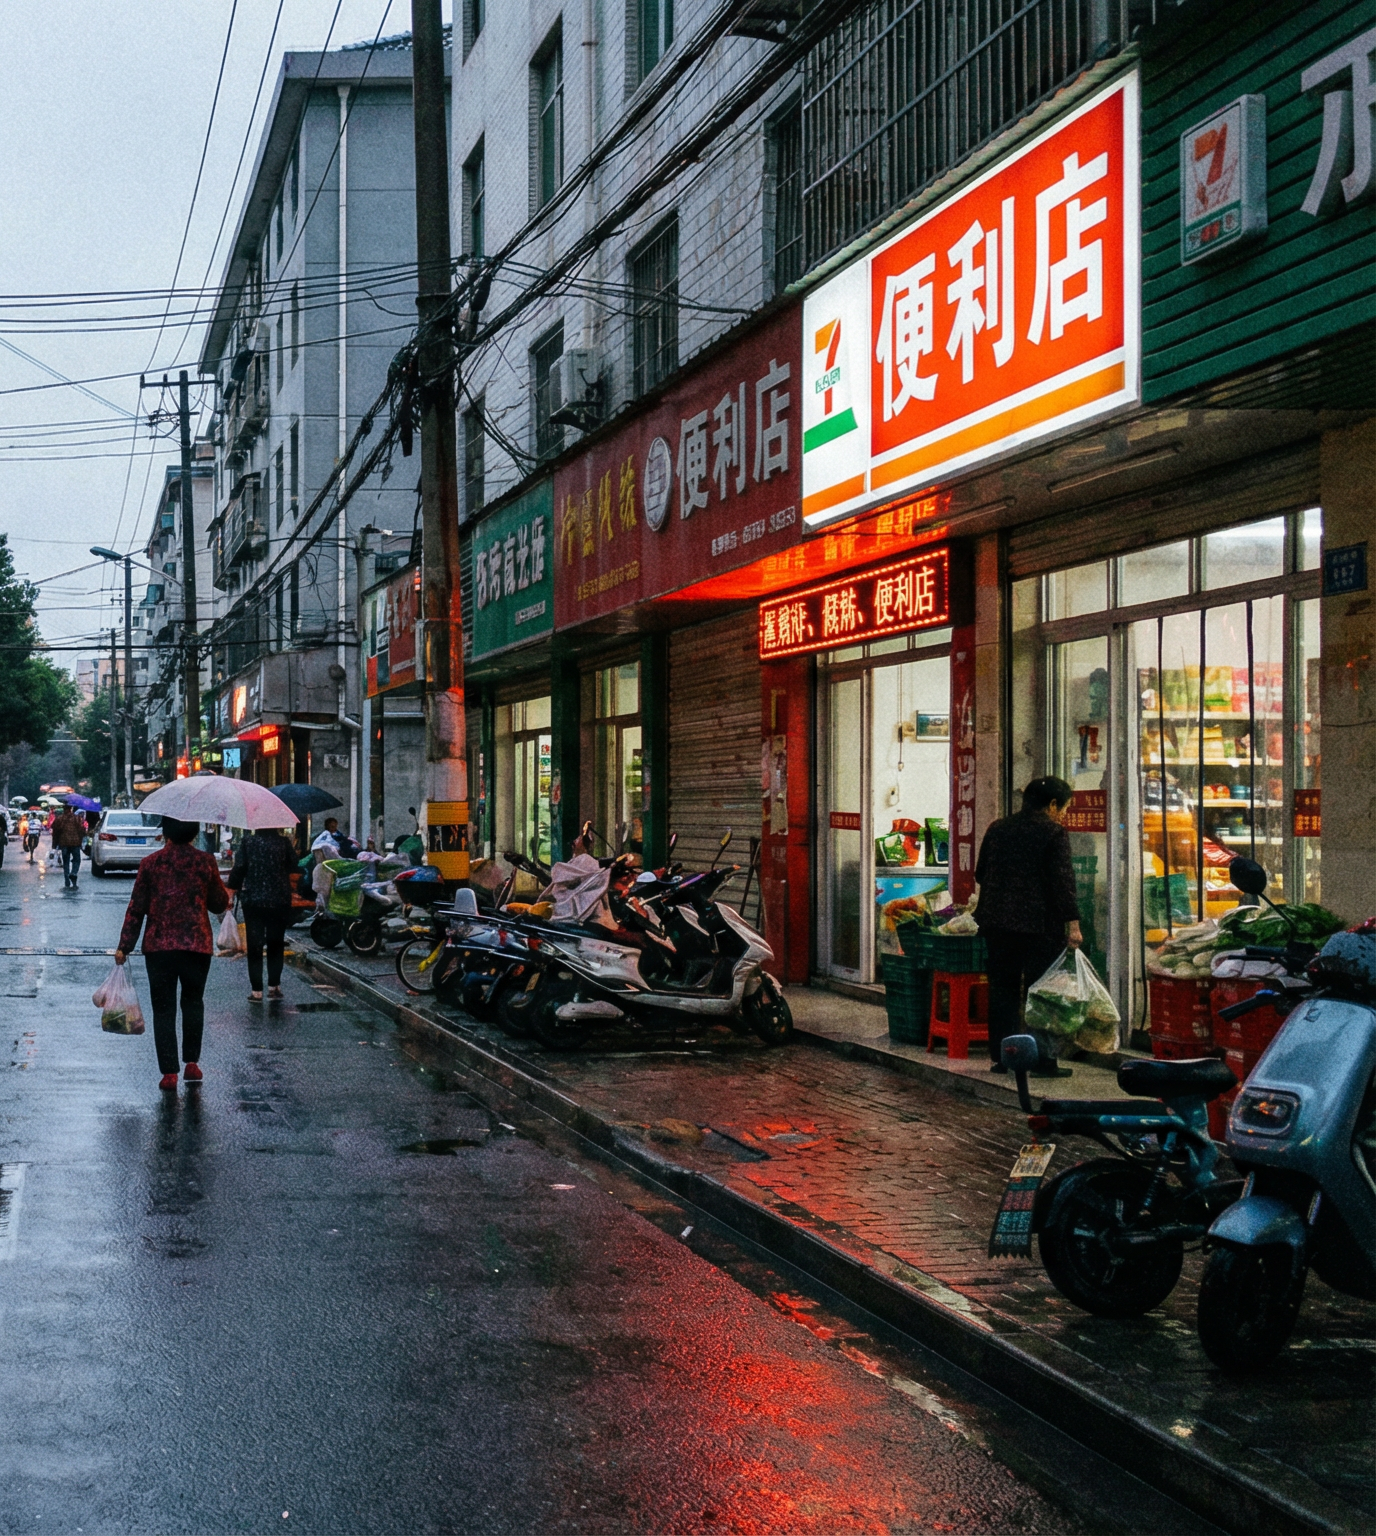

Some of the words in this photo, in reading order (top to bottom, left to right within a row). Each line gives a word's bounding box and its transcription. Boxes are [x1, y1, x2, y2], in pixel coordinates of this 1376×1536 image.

[875, 151, 1108, 423] 便利店
[676, 358, 791, 520] 便利店
[874, 565, 935, 625] 便利店
